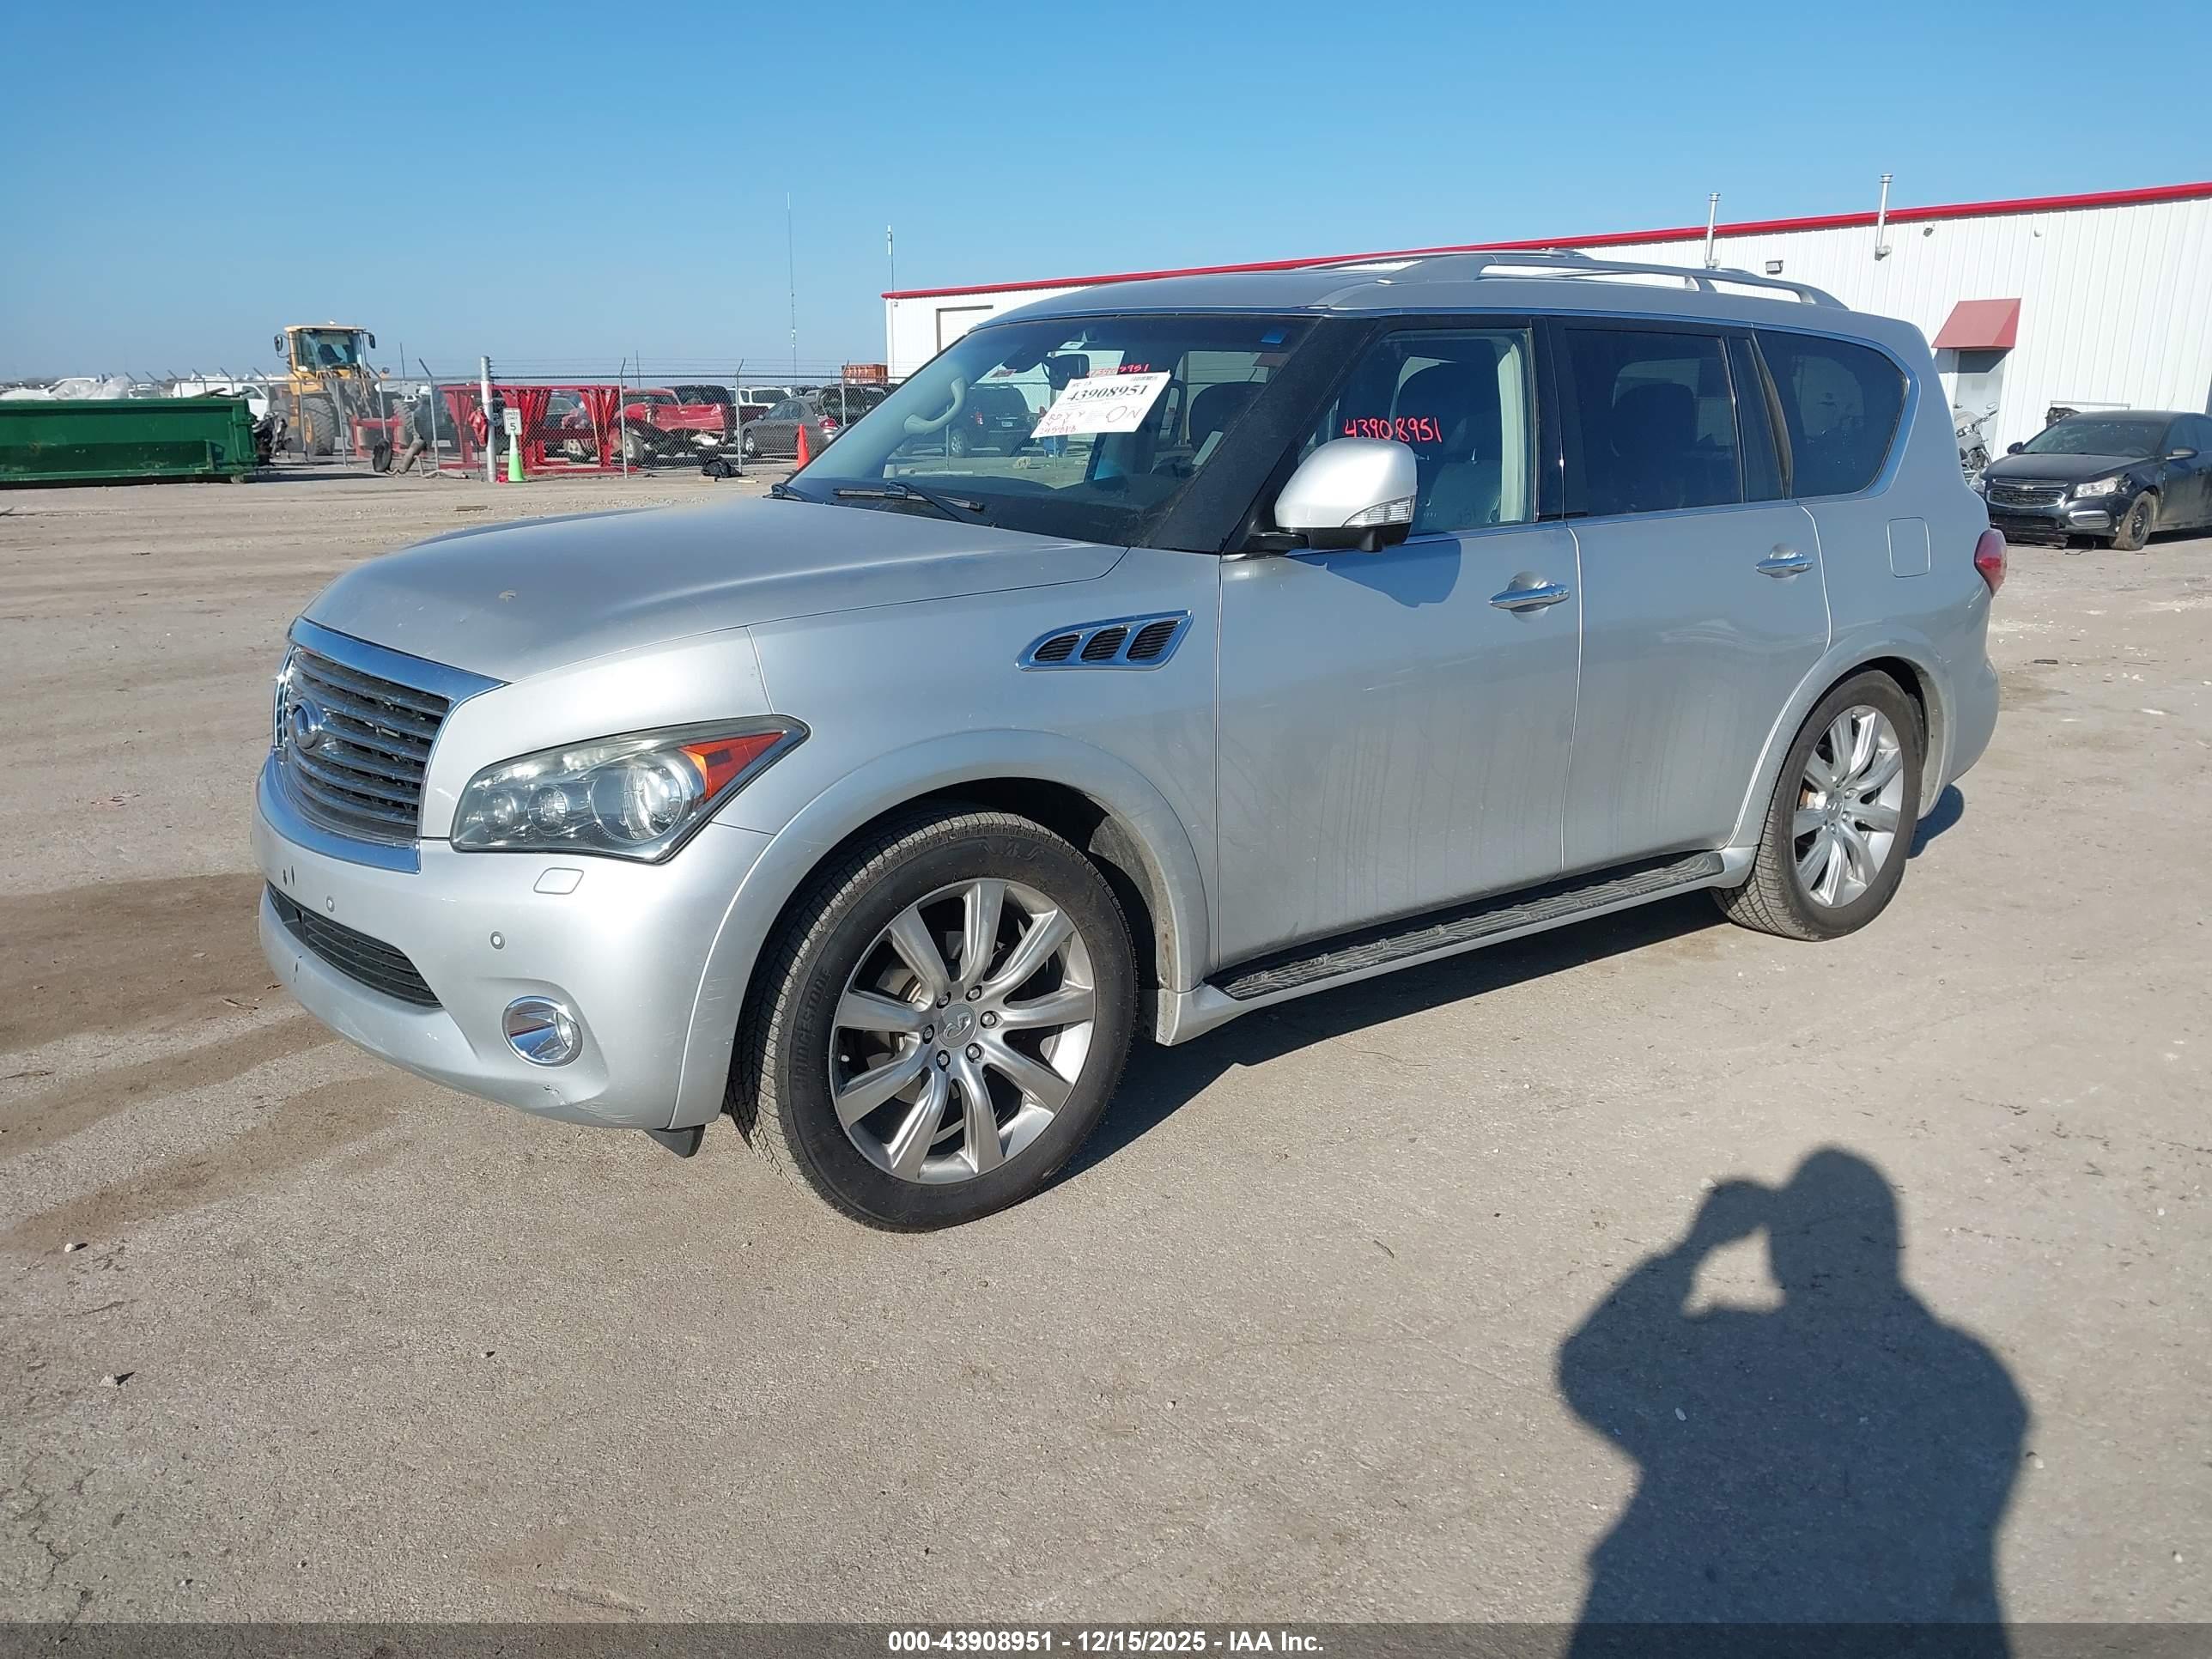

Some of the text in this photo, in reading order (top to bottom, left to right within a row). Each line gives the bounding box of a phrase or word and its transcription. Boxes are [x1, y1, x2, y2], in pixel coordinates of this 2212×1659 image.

[1067, 385, 1148, 401] 43908951
[510, 422, 517, 431] 5
[1345, 416, 1443, 443] 43908951
